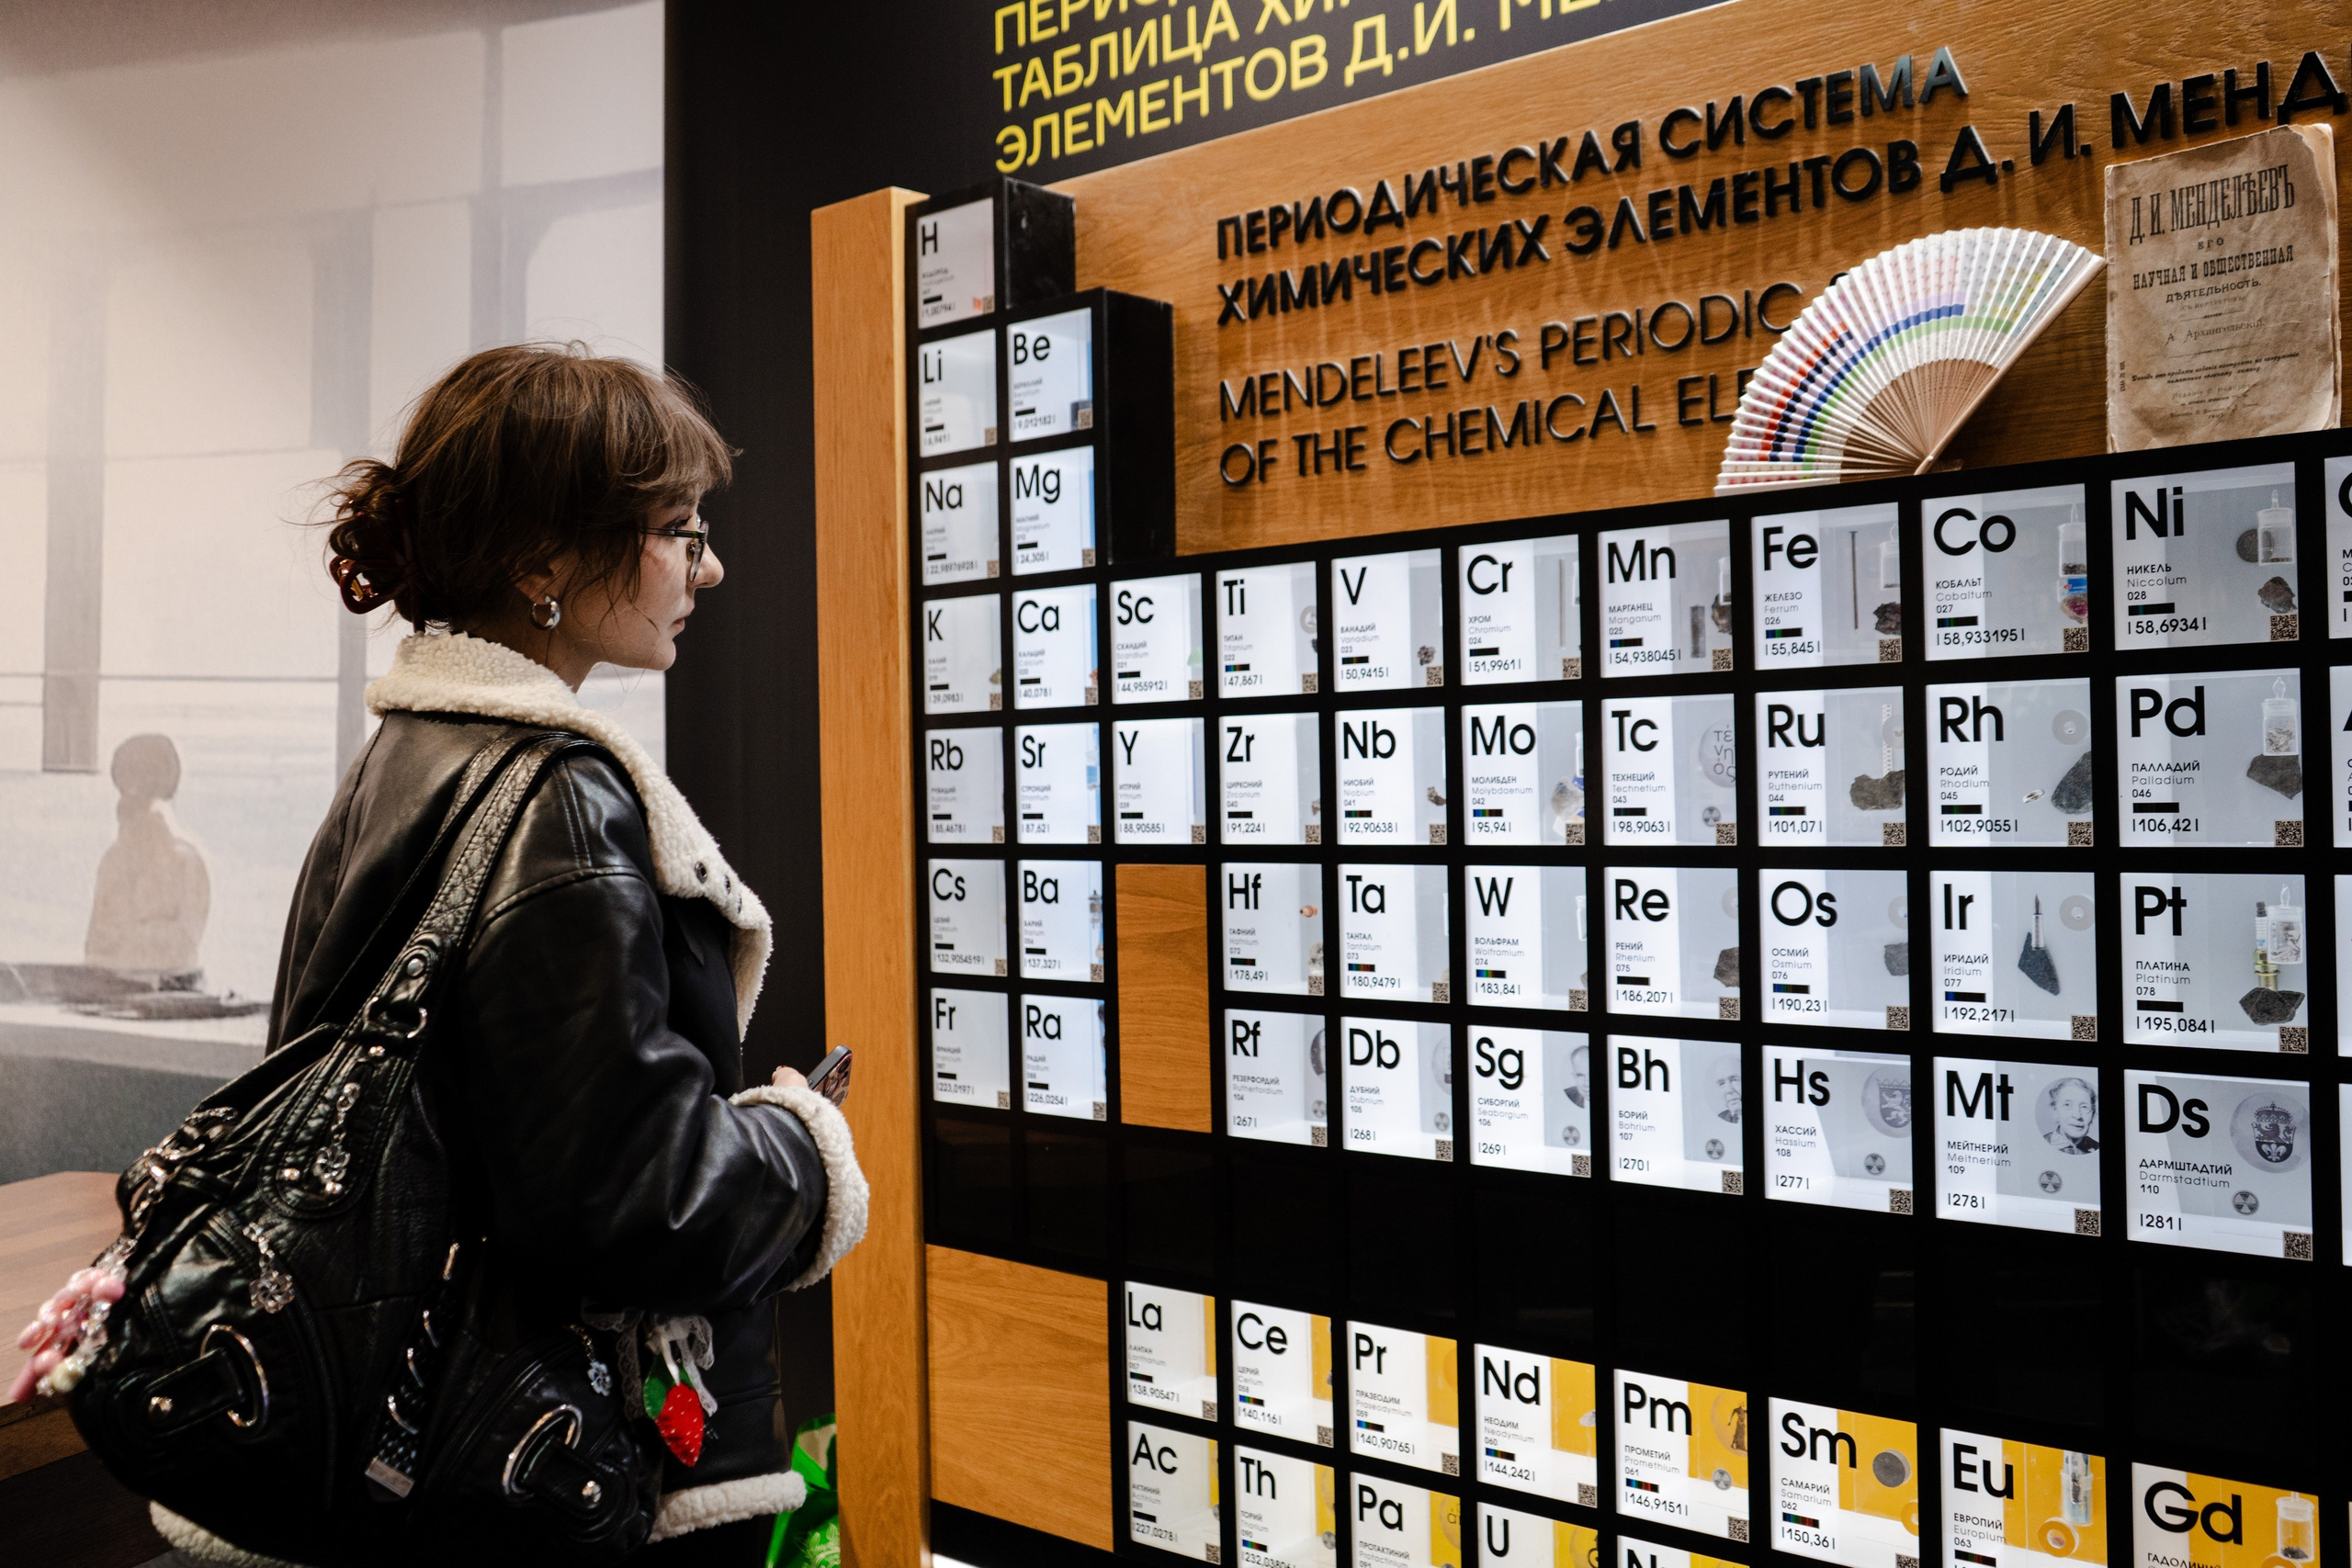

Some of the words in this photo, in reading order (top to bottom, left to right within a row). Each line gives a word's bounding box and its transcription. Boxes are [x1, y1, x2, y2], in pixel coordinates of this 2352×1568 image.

[992, 0, 1239, 112] ТАБЛИЦА
[995, 34, 1329, 173] ЭЛЕМЕНТОВ
[1216, 119, 1641, 260] ПЕРИОДИЧЕСКАЯ
[1658, 47, 1968, 158] СИСТЕМА
[1216, 215, 1550, 326] ХИМИЧЕСКИХ
[1564, 140, 1921, 254] ЭЛЕМЕНТОВ
[1939, 126, 2014, 192] Д.
[2029, 104, 2092, 165] И.
[2110, 43, 2352, 149] МЕНД
[2130, 196, 2145, 246] Д.
[922, 221, 938, 256] H
[2198, 236, 2224, 251] ЕГО
[2132, 265, 2186, 290] НАУЧНАЯ
[2190, 263, 2198, 280] И
[2203, 243, 2294, 278] ОБЩЕСТВЕННАЯ
[1013, 333, 1050, 366] Be
[1220, 328, 1521, 422] MENDELEEV'S
[1541, 282, 1803, 370] PERIODIC
[923, 350, 942, 384] Li
[1220, 439, 1279, 487] OF
[1291, 427, 1368, 478] THE
[1385, 384, 1657, 462] CHEMICAL
[926, 479, 962, 513] Na
[1016, 464, 1060, 504] Mg
[2125, 486, 2184, 541] Ni
[1763, 526, 1818, 571] Fe
[1933, 508, 2017, 556] Co
[1467, 554, 1512, 595] Cr
[1608, 539, 1677, 583] Mn
[2126, 563, 2173, 575] НИКЕЛЬ
[1223, 579, 1245, 615] Ti
[1340, 567, 1367, 605] V
[1764, 592, 1803, 602] ЖЕЛЕЗО
[1935, 578, 1983, 589] КОБАЛЬТ
[1935, 591, 1993, 602] Cobaltum
[2126, 576, 2187, 588] Niccolum
[2127, 591, 2147, 601] 028
[1017, 600, 1059, 634] Ca
[1117, 590, 1154, 626] Sc
[1608, 603, 1654, 613] МАРГАНЕЦ
[1608, 615, 1662, 625] Manganum
[1764, 605, 1799, 614] Ferrum
[1764, 616, 1781, 626] 026
[1936, 604, 1953, 614] 027
[928, 609, 943, 641] K
[1609, 626, 1623, 636] 025
[1768, 704, 1826, 748] Ru
[1939, 695, 2004, 743] Rh
[2130, 685, 2206, 738] Pd
[1227, 727, 1255, 762] Zr
[1343, 720, 1396, 759] Nb
[1471, 716, 1536, 756] Mo
[1611, 710, 1658, 751] Tc
[931, 739, 964, 771] Rb
[1022, 735, 1046, 769] Sr
[1119, 730, 1138, 765] Y
[1611, 772, 1656, 782] ТЕХНЕЦИЙ
[1768, 769, 1810, 779] РУТЕНИЙ
[1939, 765, 1978, 776] РОДИЙ
[1939, 777, 1990, 789] Rhodium
[2131, 760, 2200, 773] ПАЛЛАДИЙ
[2131, 775, 2195, 785] Palladium
[1611, 784, 1667, 793] Technetium
[1612, 795, 1627, 804] 043
[1768, 782, 1823, 791] Ruthenium
[1769, 794, 1784, 802] 044
[1940, 792, 1958, 800] 045
[2132, 789, 2152, 798] 046
[933, 868, 966, 901] Cs
[1023, 870, 1058, 904] Ba
[1228, 873, 1261, 909] Hf
[1346, 874, 1385, 914] Ta
[1475, 876, 1513, 917] W
[1615, 879, 1669, 922] Re
[1771, 881, 1838, 928] Os
[1944, 884, 1973, 930] Ir
[2134, 886, 2188, 936] Pt
[1615, 942, 1644, 950] РЕНИЙ
[1615, 953, 1656, 962] Rhenium
[1771, 948, 1809, 957] ОСМИЙ
[1943, 953, 1989, 964] ИРИДИЙ
[1615, 964, 1631, 973] 075
[1771, 959, 1813, 969] Osmium
[1772, 971, 1788, 980] 076
[1943, 966, 1983, 976] Iridium
[2135, 961, 2190, 971] ПЛАТИНА
[2135, 973, 2191, 985] Platinum
[1943, 978, 1962, 987] 077
[2135, 987, 2156, 996] 078
[935, 998, 956, 1031] Fr
[1026, 1004, 1061, 1040] Ra
[1232, 1020, 1261, 1057] Rf
[1349, 1028, 1400, 1069] Db
[1476, 1037, 1524, 1090] Sg
[1618, 1047, 1669, 1092] Bh
[1774, 1058, 1830, 1107] Hs
[1946, 1070, 2014, 1122] Mt
[1618, 1111, 1648, 1120] БОРИЙ
[1618, 1121, 1656, 1132] Bohrium
[2138, 1083, 2210, 1138] Ds
[1619, 1133, 1634, 1141] 107
[1775, 1125, 1816, 1136] ХАССИЙ
[1775, 1136, 1816, 1148] Hassium
[1776, 1148, 1792, 1157] 108
[1947, 1141, 2009, 1154] МЕЙТНЕРИЙ
[1947, 1153, 2011, 1167] Meitnerium
[1947, 1165, 1965, 1174] 109
[2139, 1158, 2233, 1175] ДАРМШТАДТИЙ
[2139, 1171, 2231, 1188] Darmstadtium
[2140, 1184, 2159, 1194] 110
[1128, 1292, 1162, 1332] La
[1237, 1313, 1287, 1355] Ce
[1355, 1333, 1386, 1374] Pr
[1483, 1356, 1541, 1405] Nd
[1623, 1382, 1692, 1437] Pm
[1132, 1433, 1178, 1474] Ac
[1624, 1444, 1671, 1461] ПРОМЕТИЙ
[1781, 1412, 1858, 1469] Sm
[1239, 1456, 1276, 1499] Th
[1624, 1456, 1680, 1474] Promethium
[1624, 1466, 1639, 1476] 061
[1953, 1442, 2015, 1500] Eu
[1781, 1477, 1830, 1495] САМАРИЙ
[1781, 1489, 1832, 1507] Samarium
[1358, 1483, 1403, 1531] Pa
[1781, 1500, 1797, 1511] 062
[1953, 1512, 2003, 1530] ЕВРОПИЙ
[2144, 1481, 2243, 1545] Gd
[1487, 1515, 1510, 1558] U
[1953, 1524, 2007, 1544] Europium
[1954, 1537, 1972, 1548] 063
